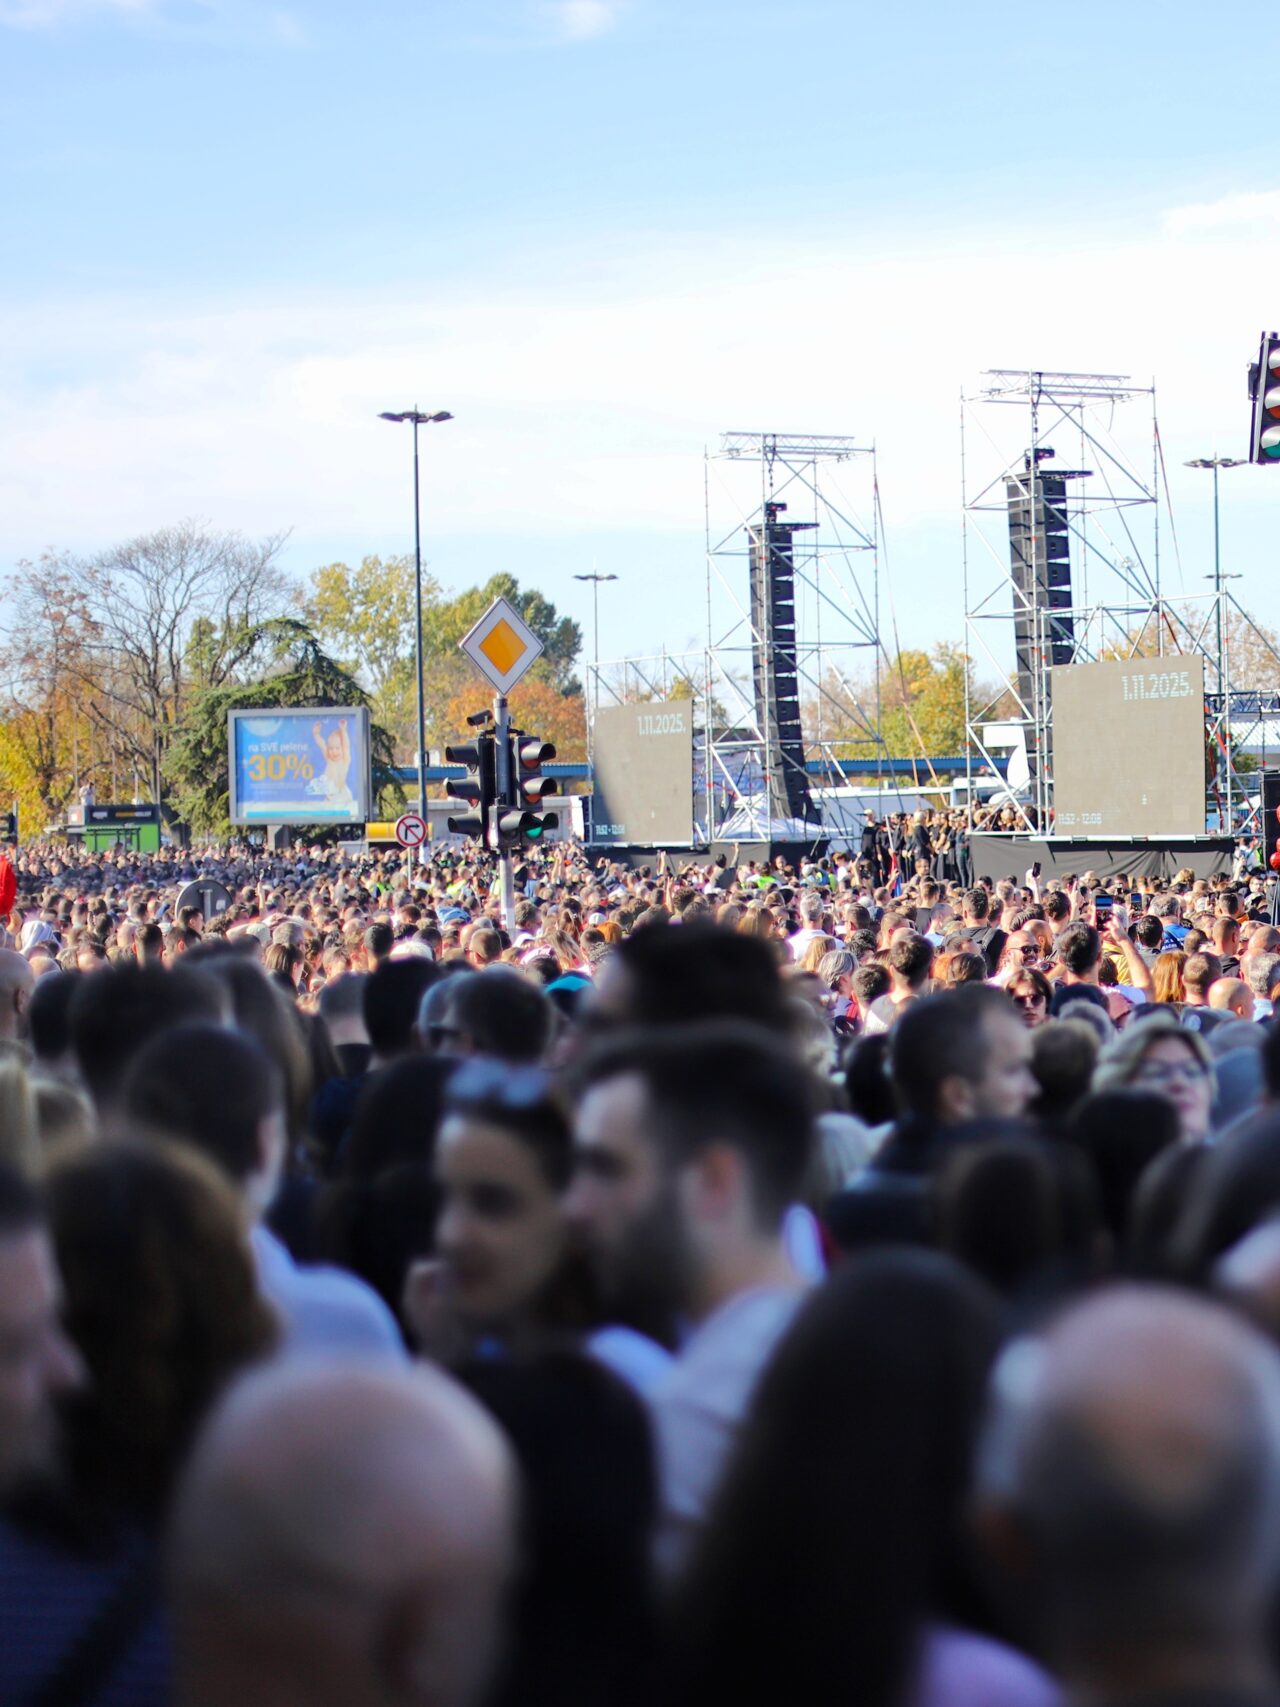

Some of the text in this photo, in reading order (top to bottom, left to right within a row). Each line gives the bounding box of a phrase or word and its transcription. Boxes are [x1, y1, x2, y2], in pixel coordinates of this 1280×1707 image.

[1122, 672, 1194, 700] 1.11.2025.
[638, 714, 686, 735] 1.11.2025.
[260, 742, 278, 752] SVE
[249, 754, 313, 780] 30%
